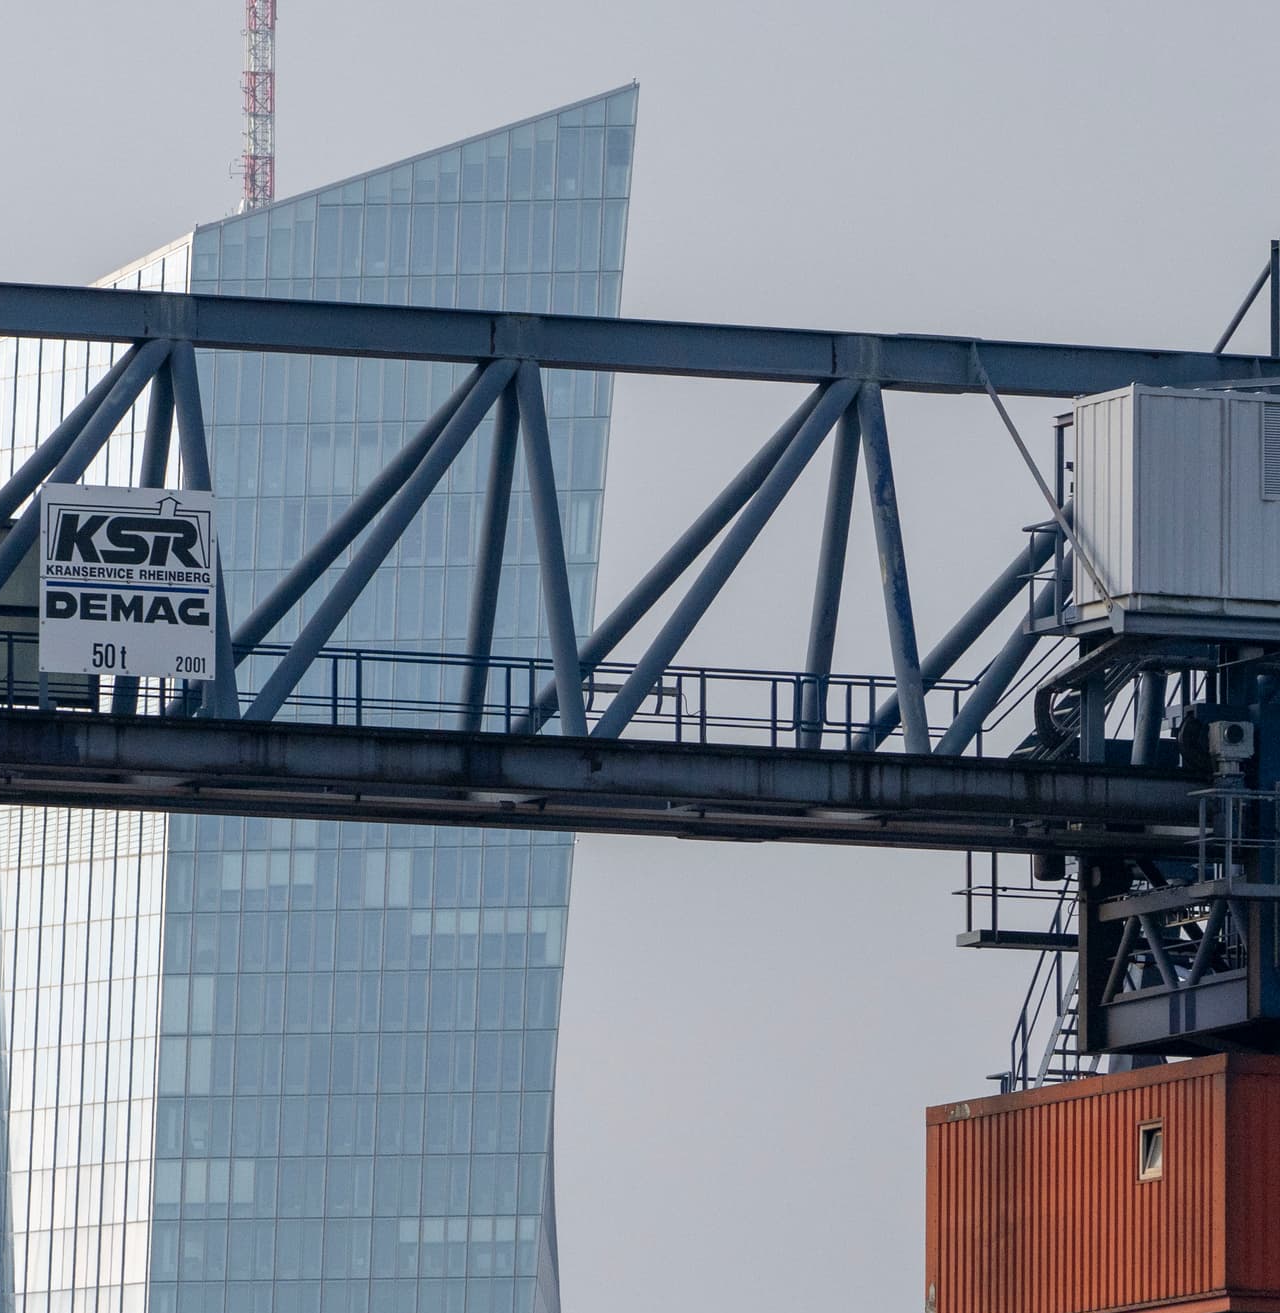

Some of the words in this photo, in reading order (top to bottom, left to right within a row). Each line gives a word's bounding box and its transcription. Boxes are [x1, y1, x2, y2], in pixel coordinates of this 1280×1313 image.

[54, 513, 204, 569] KSR
[46, 564, 134, 580] KRANSERVICE
[139, 569, 211, 584] RHEINBERG
[46, 590, 210, 626] DEMAG
[92, 642, 116, 669] 50
[175, 656, 206, 674] 2001
